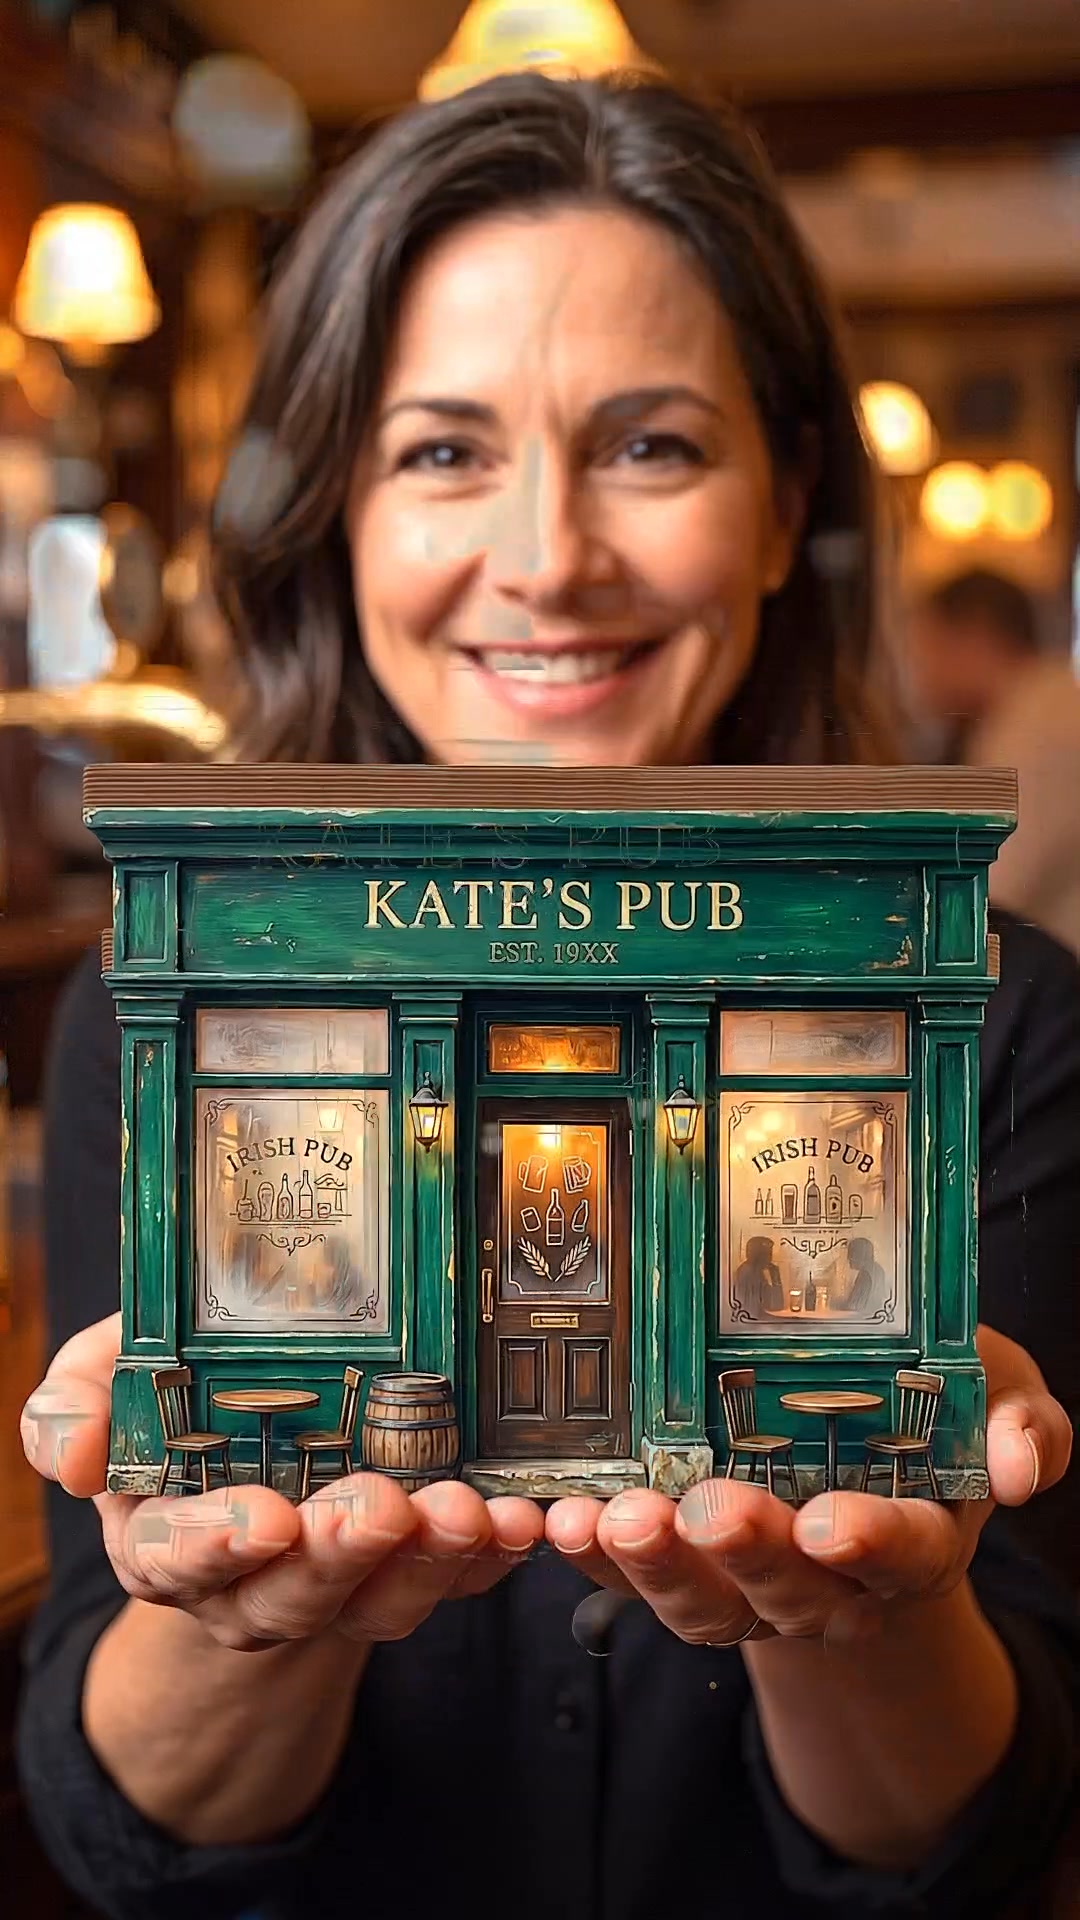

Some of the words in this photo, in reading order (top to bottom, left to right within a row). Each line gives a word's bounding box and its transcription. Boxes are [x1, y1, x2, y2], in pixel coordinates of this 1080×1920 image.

[251, 823, 529, 870] KATES
[363, 878, 593, 930] KATE'S
[615, 881, 744, 931] PUB
[488, 941, 544, 964] EST.
[553, 942, 620, 964] 19XX
[226, 1136, 296, 1173] IRISH
[304, 1138, 353, 1172] PUB
[751, 1137, 819, 1173] IRISH
[826, 1139, 874, 1173] PUB
